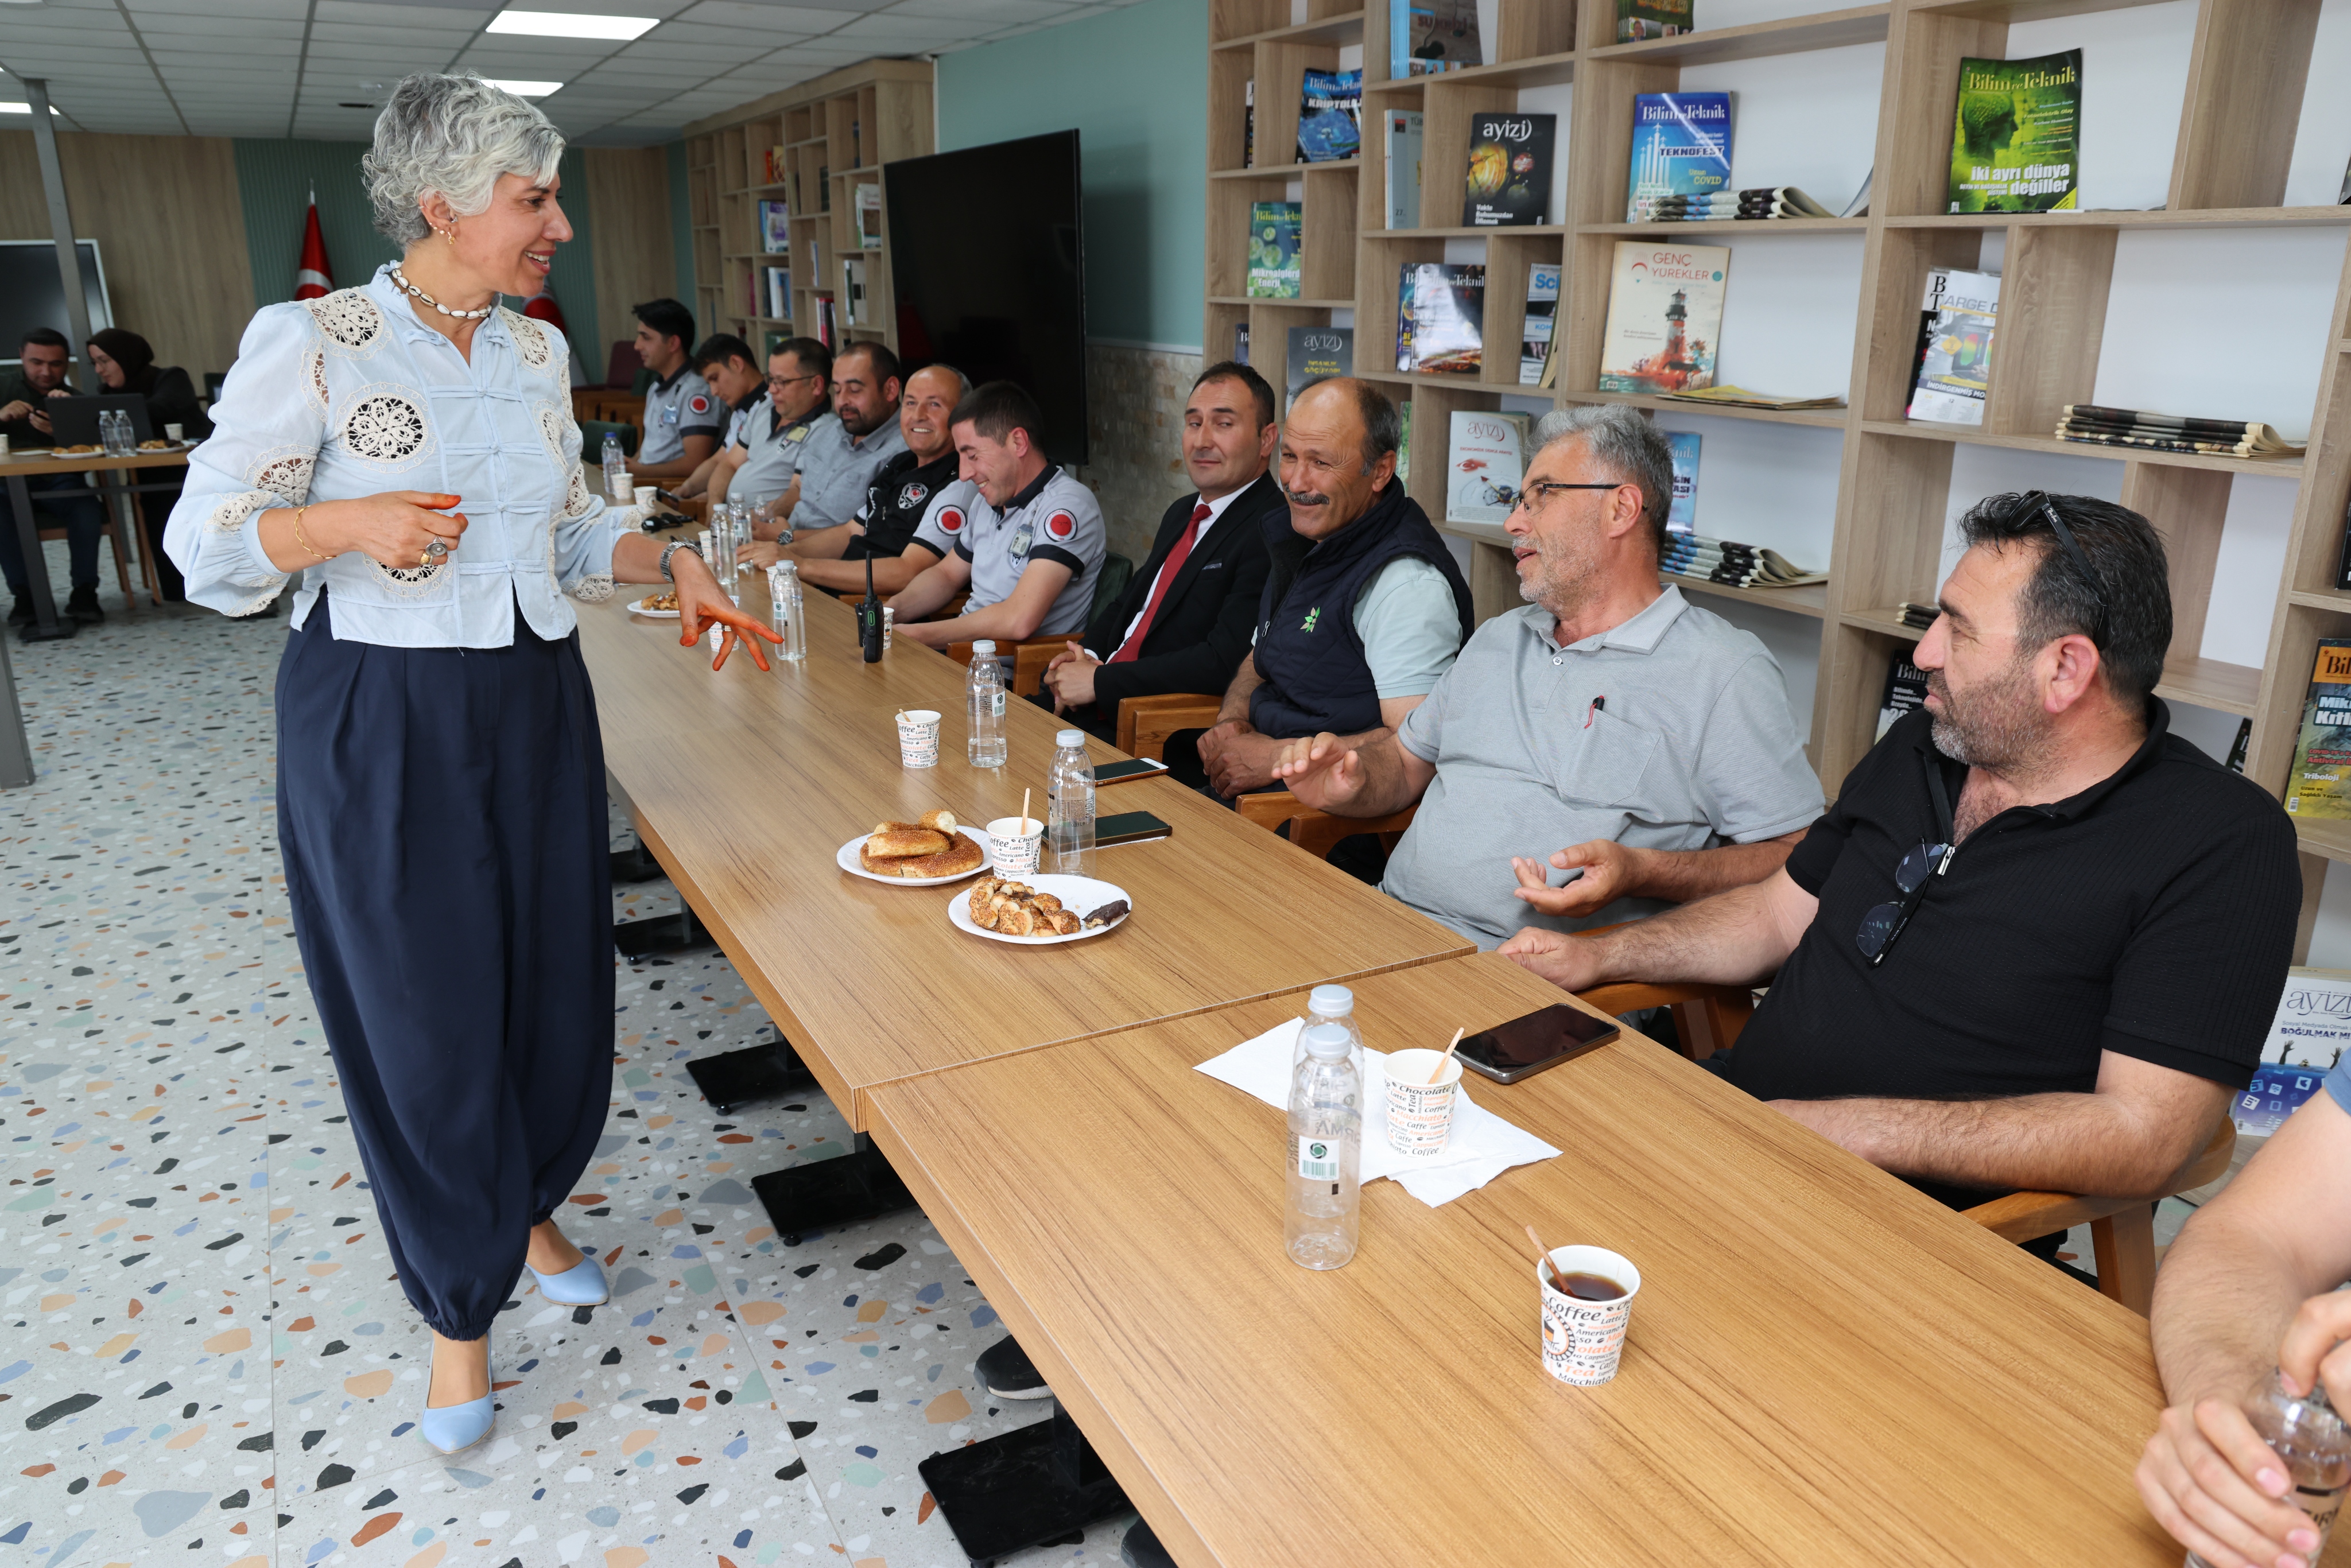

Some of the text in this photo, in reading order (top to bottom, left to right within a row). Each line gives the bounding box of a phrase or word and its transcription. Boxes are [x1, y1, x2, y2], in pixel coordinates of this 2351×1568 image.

[1970, 73, 2010, 90] Bilim
[2020, 66, 2075, 90] Teknik
[1310, 77, 1336, 91] Bilim
[1643, 104, 1725, 120] Bilim Teknik
[1483, 119, 1532, 142] ayizi
[1660, 147, 1724, 157] TEKNOFEST
[1971, 164, 2070, 181] iki ayrı dünya
[1694, 176, 1721, 184] COVID
[2010, 179, 2069, 196] değiller
[1653, 252, 1692, 266] GENÇ
[1652, 267, 1709, 280] YÜREKLER
[1258, 278, 1280, 288] Enerji
[1945, 296, 1987, 312] ARGE
[1927, 381, 1973, 396] İNDİRGENMİŞ
[1973, 390, 1986, 398] MO
[2307, 756, 2344, 765] Antiviral
[2303, 773, 2340, 782] Triboloji
[990, 838, 1008, 848] offee
[993, 860, 1022, 869] hocolate
[2281, 1027, 2337, 1038] BOĞULMAK
[1400, 1085, 1451, 1095] Chocolate
[1391, 1091, 1406, 1102] Latte
[1425, 1105, 1448, 1113] Coffee
[1396, 1109, 1442, 1122] Macchiato
[1407, 1121, 1427, 1130] Caffe
[1395, 1133, 1412, 1143] Caffe
[1413, 1139, 1444, 1148] Cappuccino
[1395, 1140, 1411, 1148] Espresso
[1412, 1148, 1439, 1156] Coffee
[1549, 1297, 1601, 1321] Coffee
[1601, 1314, 1623, 1325] Latte
[1576, 1326, 1620, 1337] Americano
[1585, 1350, 1616, 1360] Cappuccino
[1599, 1357, 1617, 1370] Caffe
[1565, 1364, 1595, 1377] Tea
[1598, 1367, 1615, 1377] Espresso
[1558, 1372, 1611, 1385] Macchiato
